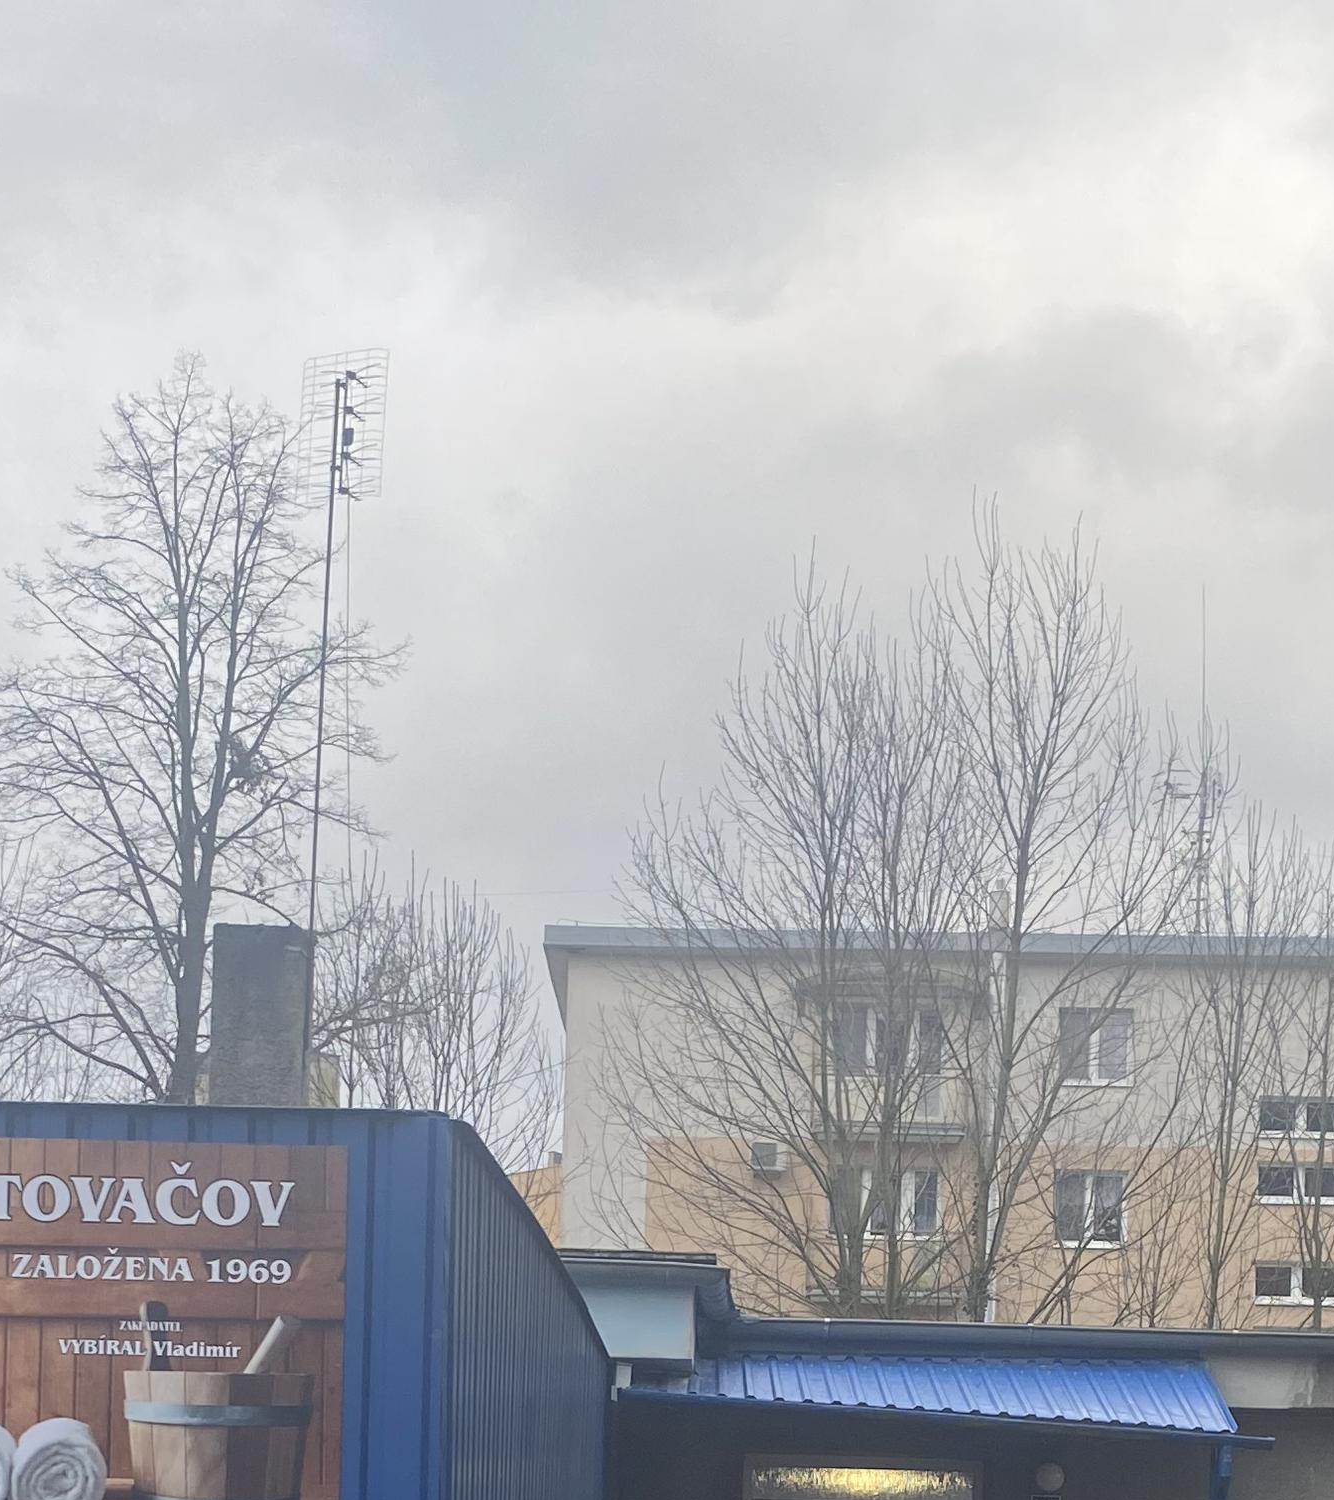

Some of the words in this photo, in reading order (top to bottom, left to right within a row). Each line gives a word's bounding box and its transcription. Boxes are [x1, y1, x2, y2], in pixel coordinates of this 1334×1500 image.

[11, 1247, 195, 1282] ZALOŽENA
[205, 1259, 293, 1285] 1969
[58, 1334, 148, 1357] VYBÍRAL
[152, 1340, 243, 1359] Vladimír
